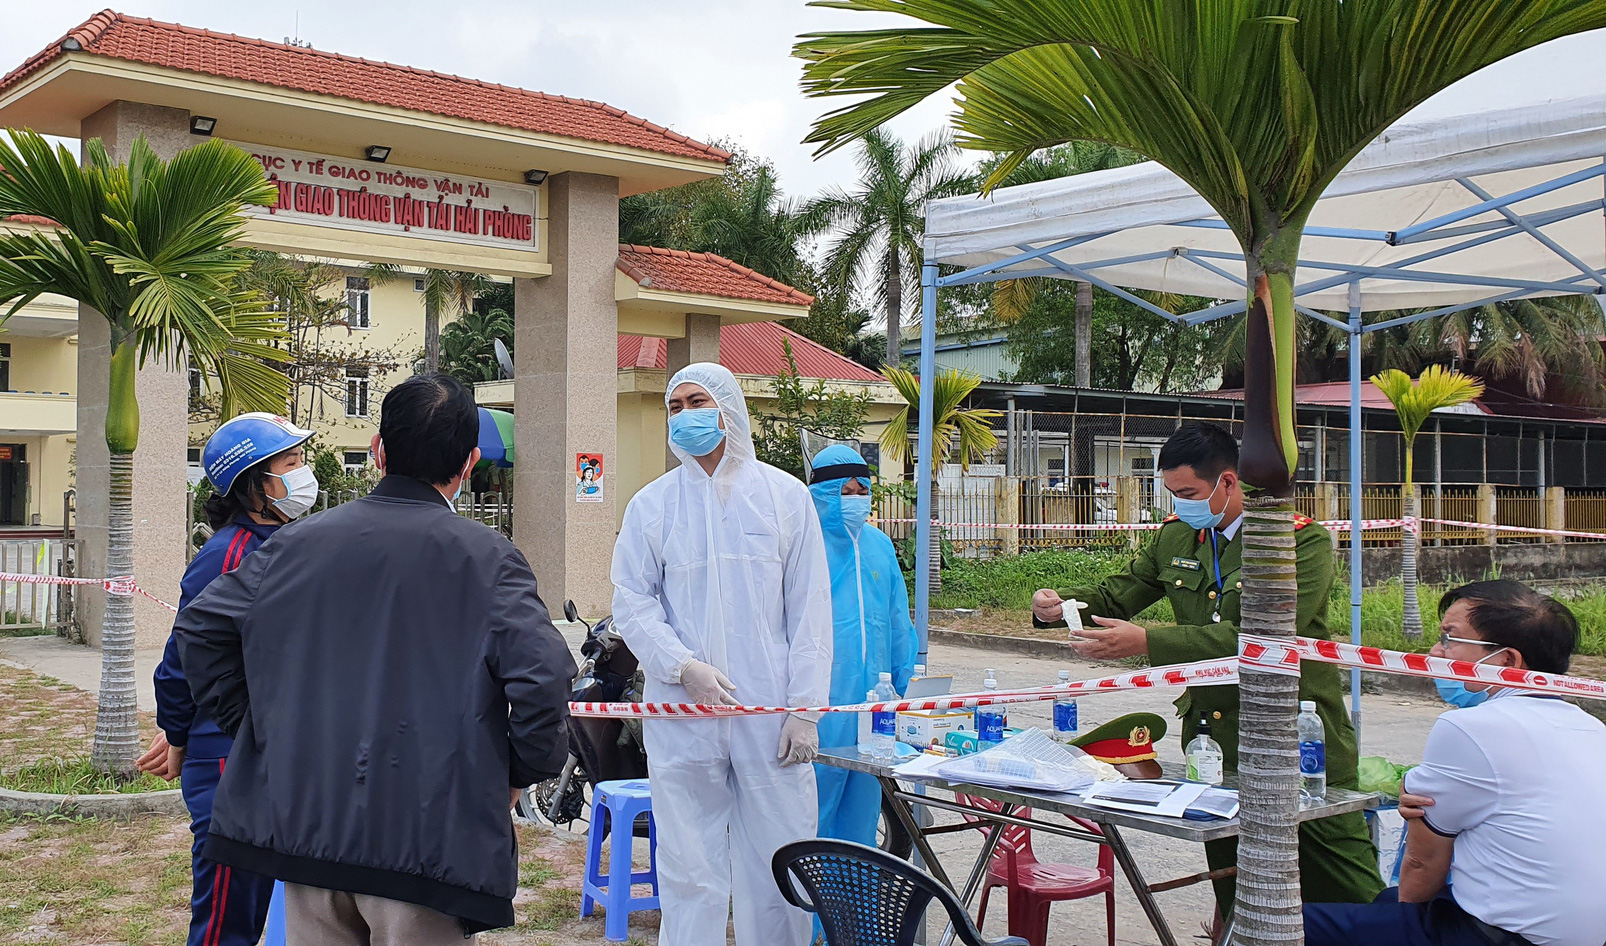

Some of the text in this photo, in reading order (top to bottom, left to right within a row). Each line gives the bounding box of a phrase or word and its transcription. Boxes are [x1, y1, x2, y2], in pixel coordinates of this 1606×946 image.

[291, 159, 303, 172] Y
[307, 159, 326, 175] TẾ
[328, 165, 371, 182] GIAO
[376, 170, 429, 190] THÔNG
[433, 178, 463, 196] VẬN
[468, 182, 490, 198] TẢI
[295, 182, 335, 216] GIAO
[337, 186, 391, 224] THÔNG
[393, 192, 425, 232] VẬN
[427, 194, 452, 231] TẢI
[453, 198, 480, 235] HẢI
[482, 205, 532, 241] PHÒNG
